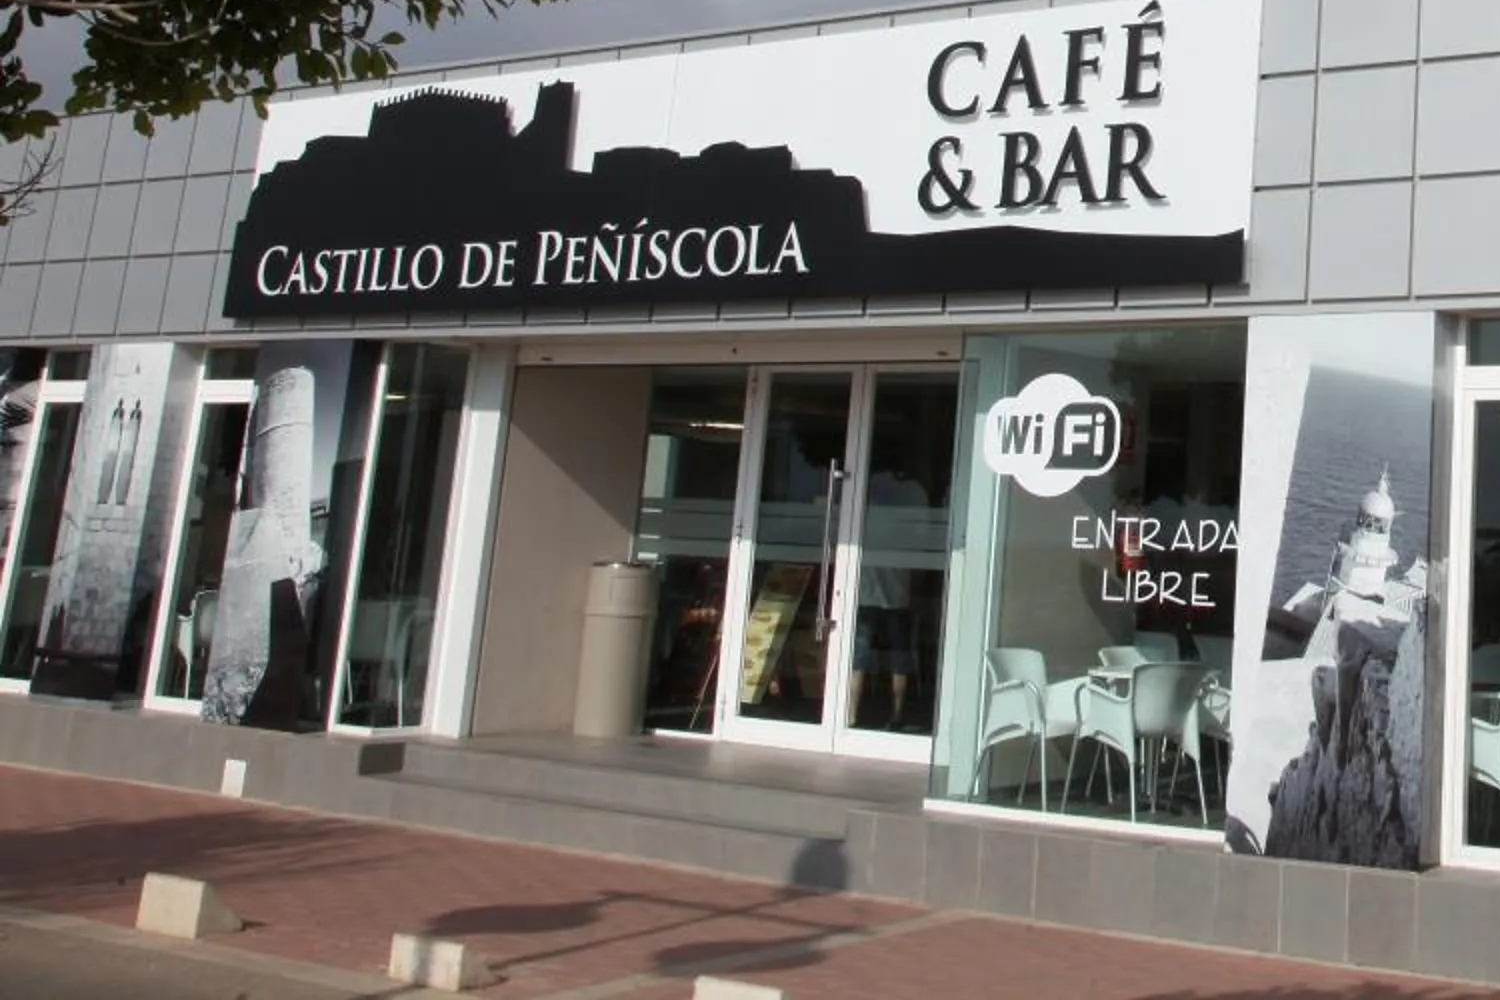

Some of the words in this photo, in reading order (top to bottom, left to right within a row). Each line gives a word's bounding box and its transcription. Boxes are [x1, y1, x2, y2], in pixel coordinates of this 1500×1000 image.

[927, 0, 1167, 120] CAFÉ
[917, 135, 984, 216] &
[993, 122, 1169, 211] BAR
[256, 243, 445, 297] CASTILLO
[457, 239, 519, 289] DE
[531, 216, 811, 287] PEÑÍSCOLA
[1071, 509, 1244, 556] ENTRADA
[1101, 567, 1217, 608] LIBRE
